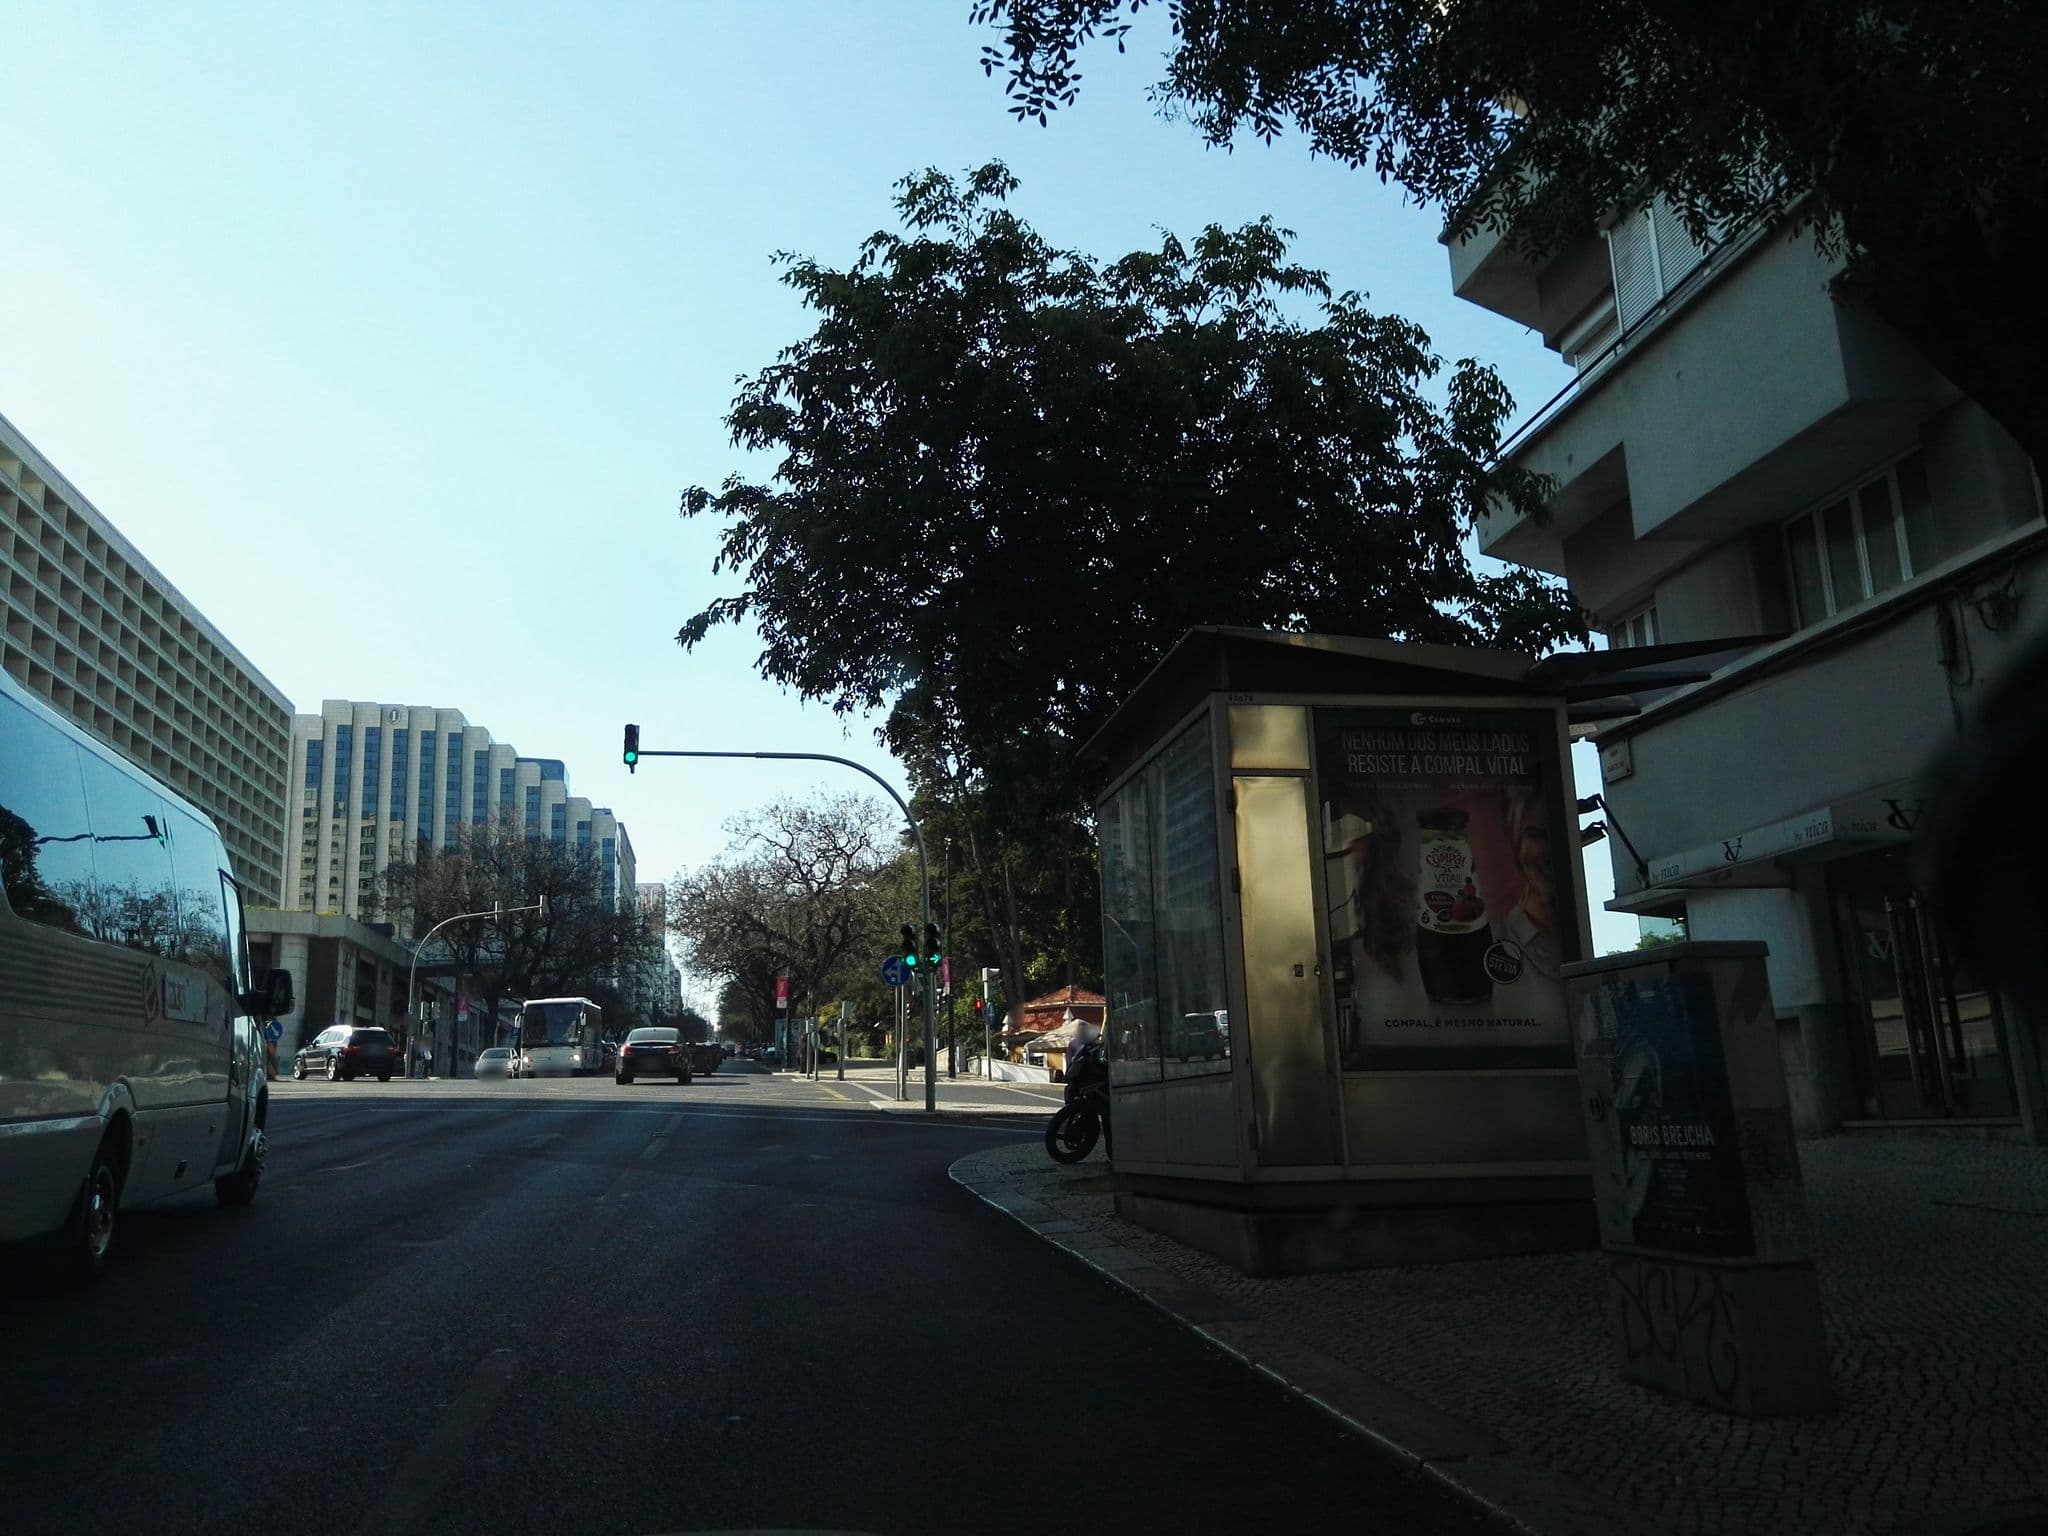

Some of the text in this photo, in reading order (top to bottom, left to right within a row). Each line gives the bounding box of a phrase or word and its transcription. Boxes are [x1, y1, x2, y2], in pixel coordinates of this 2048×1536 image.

[1342, 732, 1530, 754] NENHUM DOS MEUS LADOS
[1347, 754, 1528, 776] RESISTE A COMPAL VITAL
[1805, 819, 1829, 841] nica
[1852, 820, 1877, 833] nica
[1384, 1018, 1433, 1029] COMPAL.
[1444, 1017, 1483, 1028] MESMO
[1487, 1017, 1541, 1028] NATURAL.
[1630, 1125, 1715, 1146] BORIS BREJCHA
